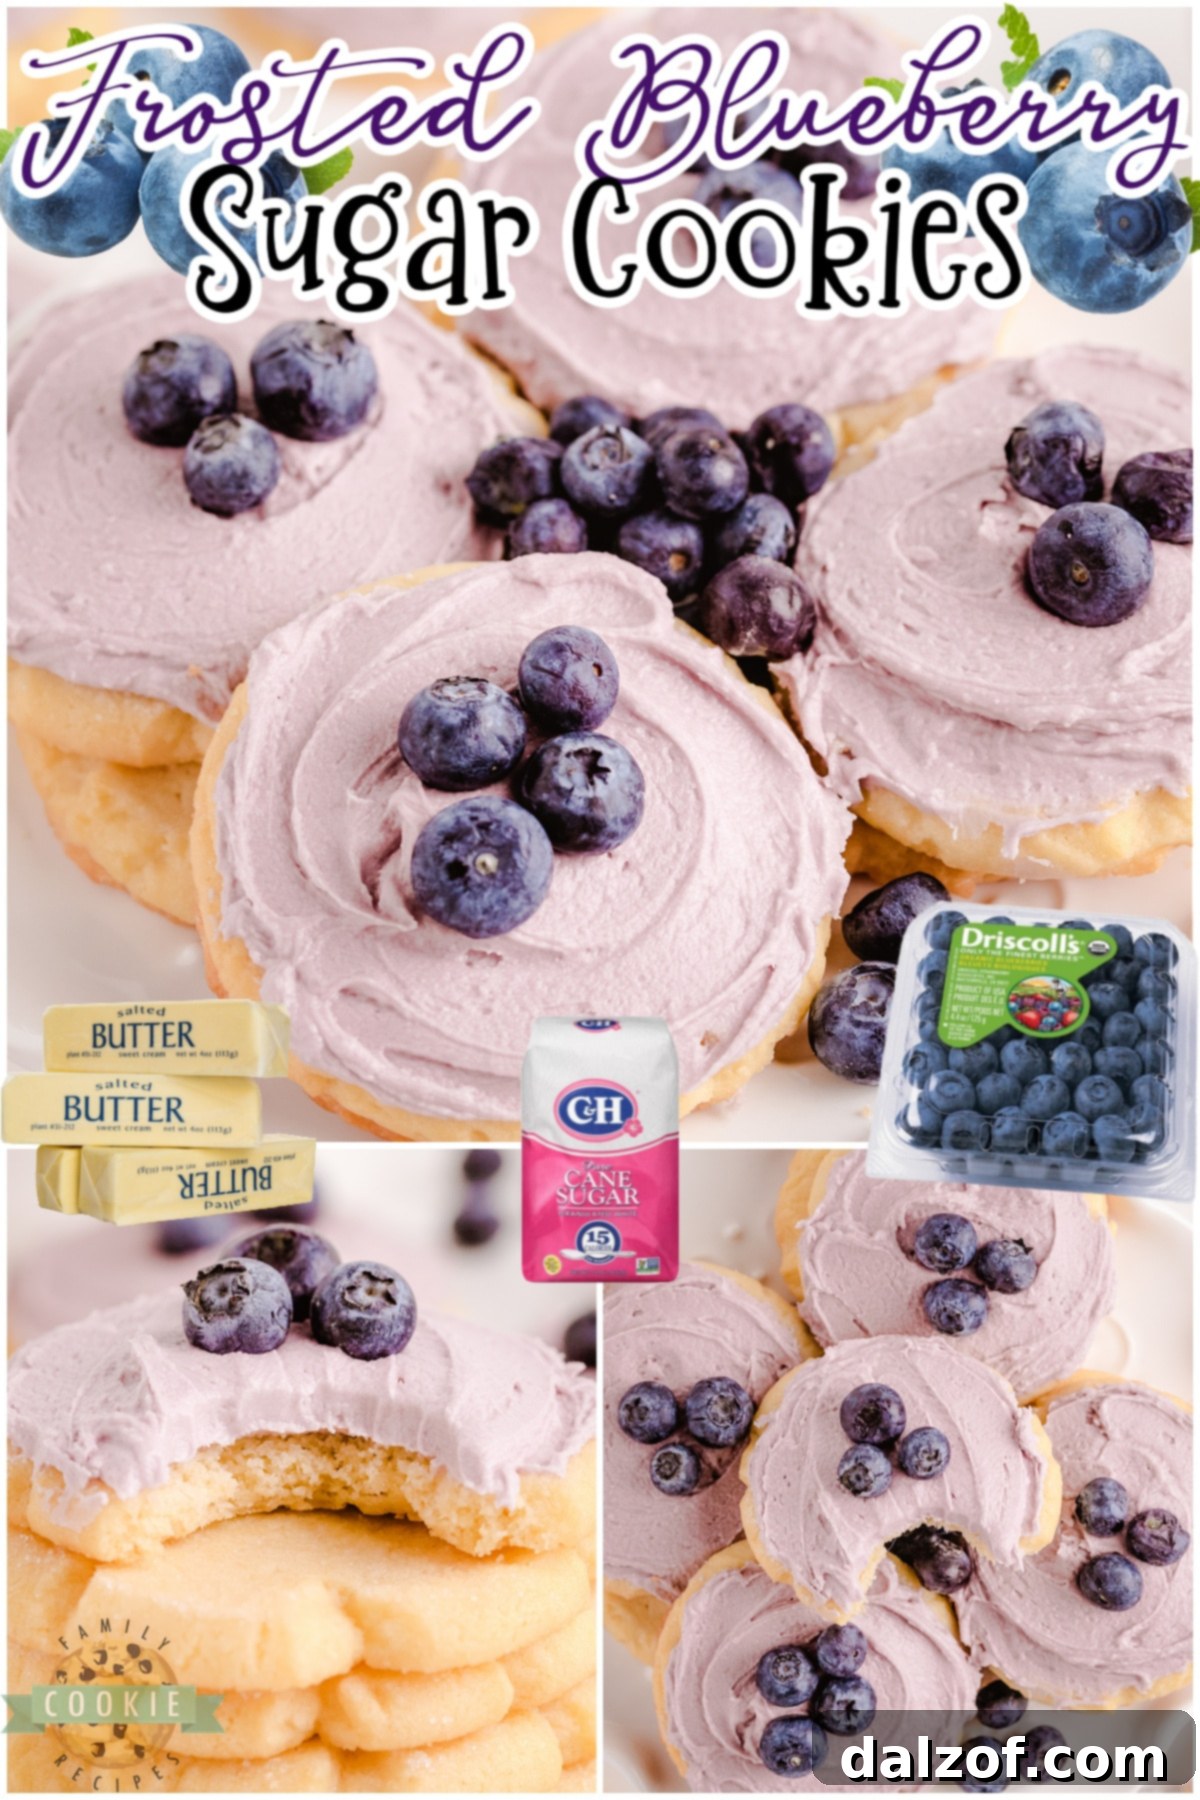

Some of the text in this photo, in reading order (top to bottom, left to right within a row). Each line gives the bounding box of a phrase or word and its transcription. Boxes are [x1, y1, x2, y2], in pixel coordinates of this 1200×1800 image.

[1006, 950, 1037, 959] FINEST
[117, 1005, 166, 1018] salted
[91, 1021, 195, 1049] BUTTER
[95, 1079, 152, 1091] salted
[64, 1095, 185, 1123] BUTTER
[566, 1096, 624, 1125] C&H
[177, 1165, 272, 1200] BUTTER
[564, 1169, 632, 1188] CANE
[204, 1196, 248, 1211] salted
[556, 1188, 640, 1206] SUGAR
[586, 1230, 610, 1245] 15
